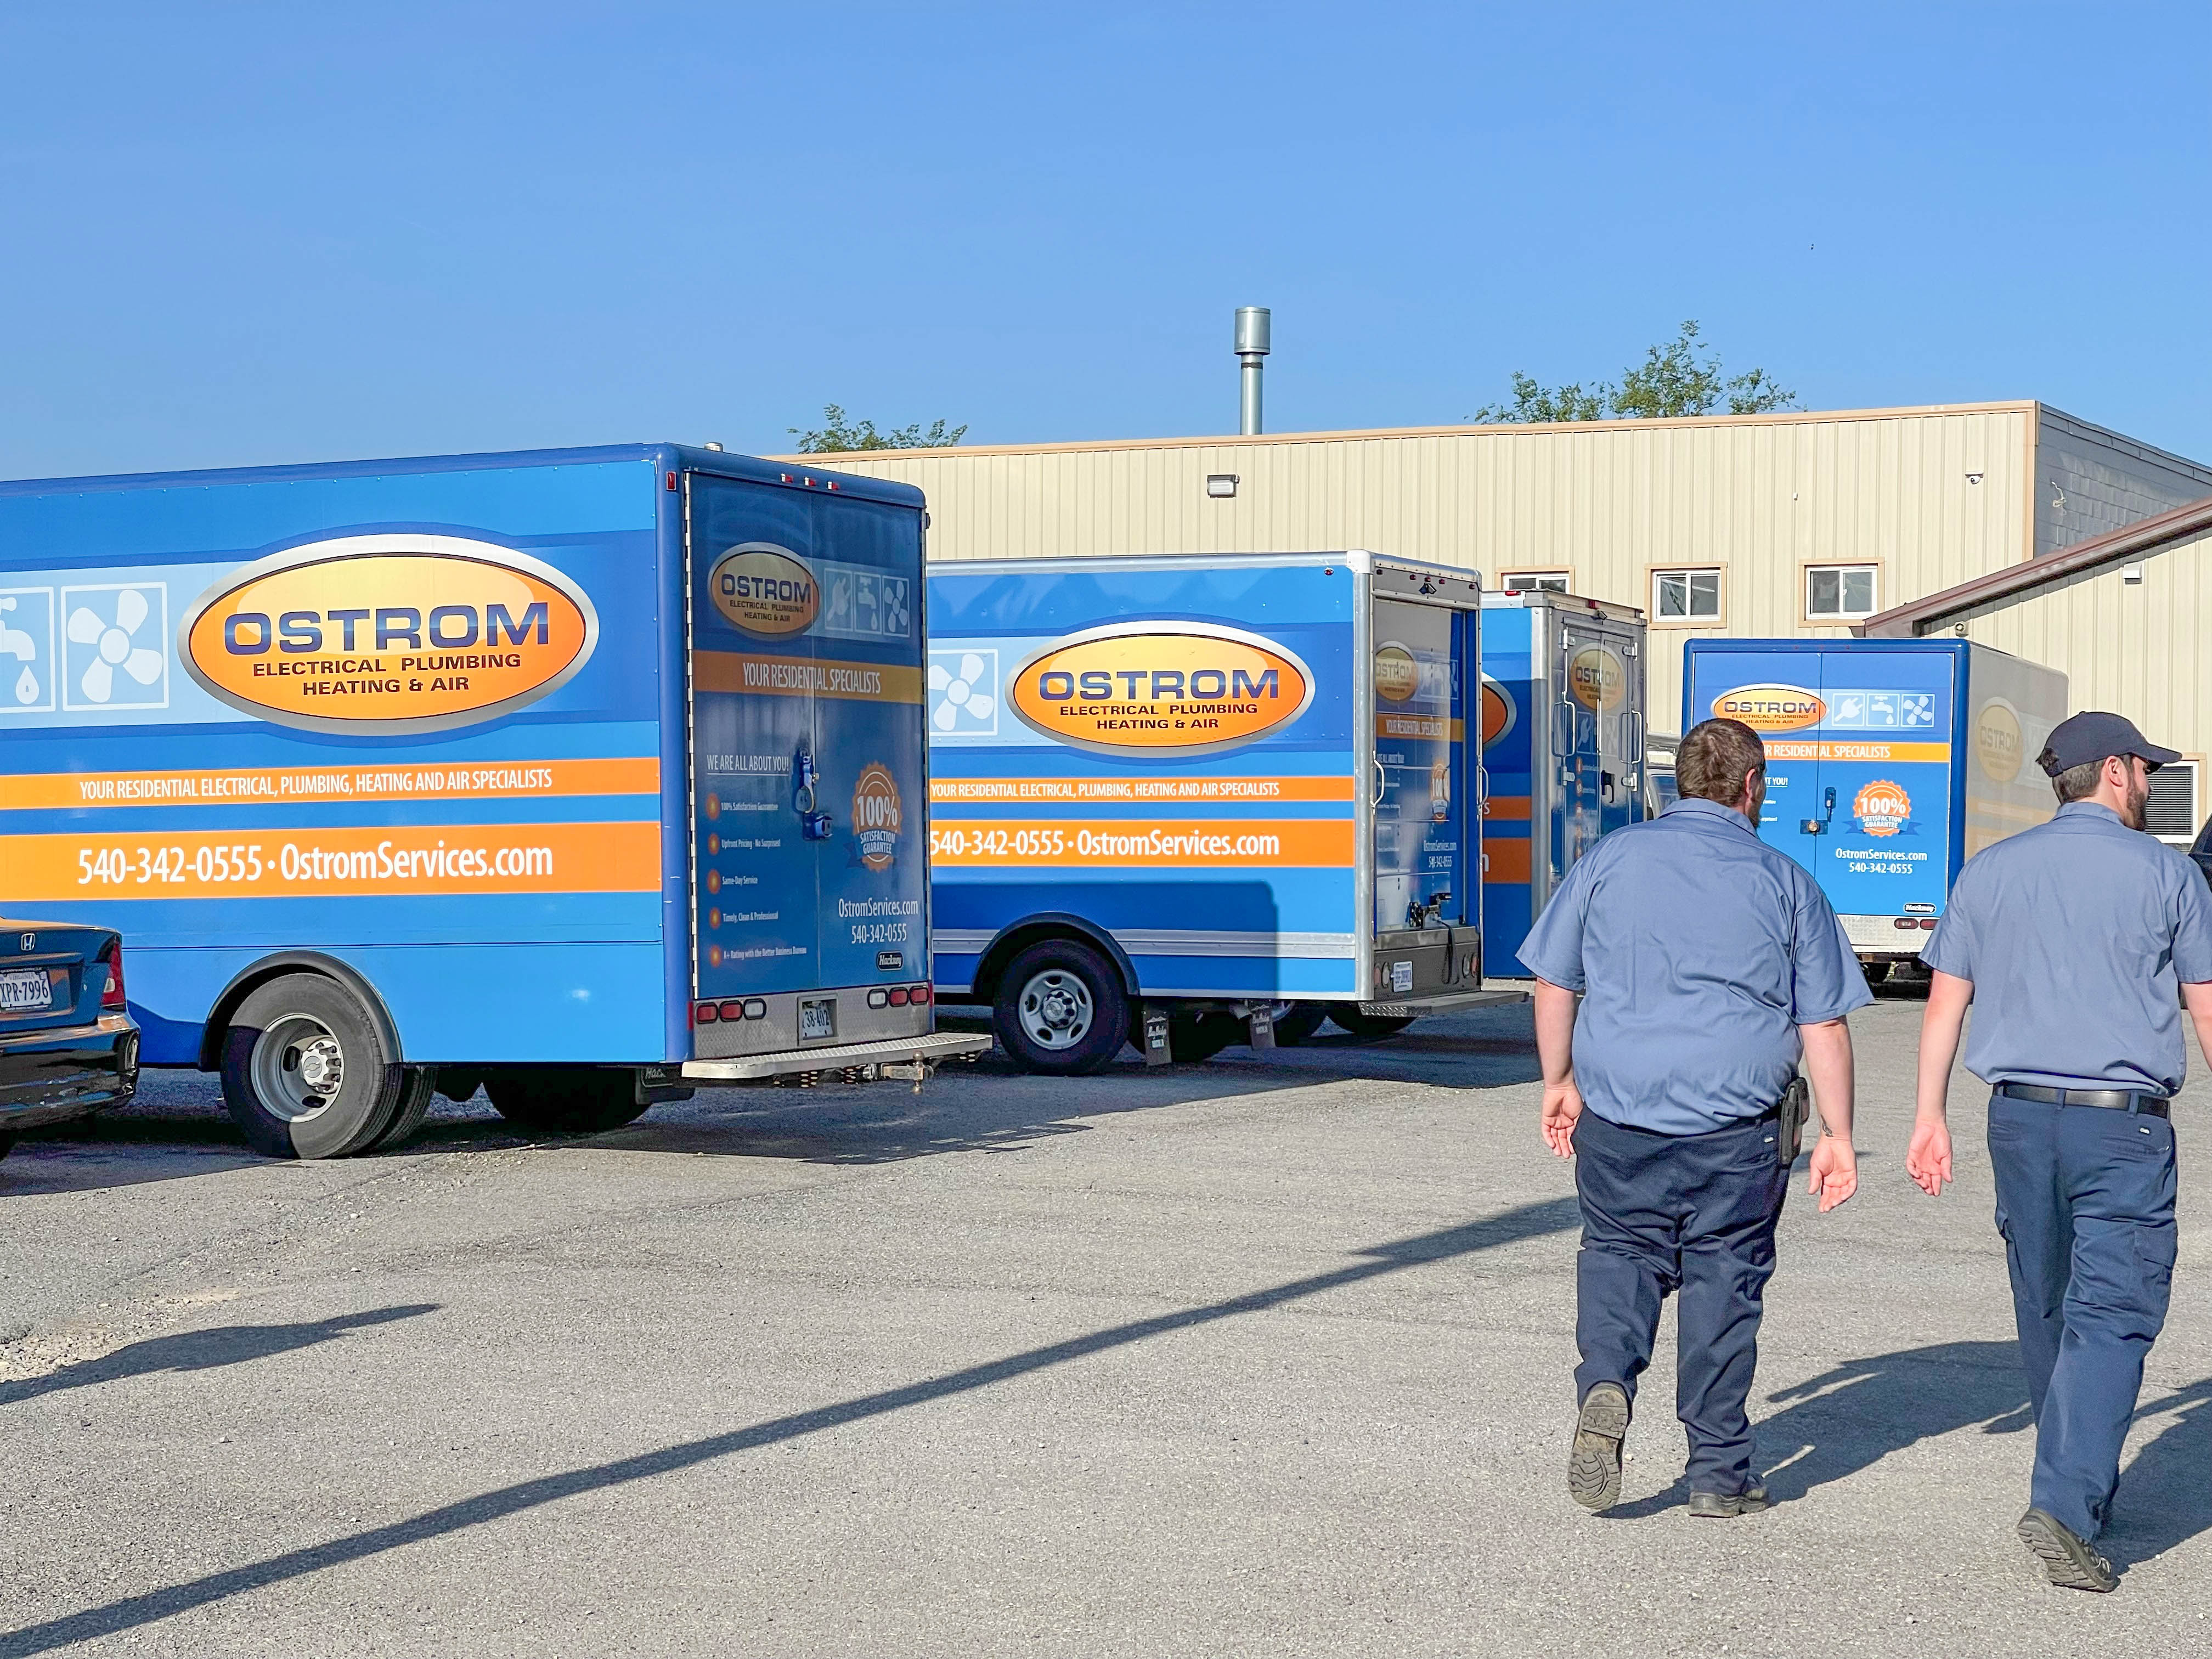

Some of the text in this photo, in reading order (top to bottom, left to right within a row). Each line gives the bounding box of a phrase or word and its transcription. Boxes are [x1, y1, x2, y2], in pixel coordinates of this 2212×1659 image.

[721, 574, 810, 603] OSTROM
[730, 600, 804, 613] ELECTRICAL PLUMBING
[744, 612, 772, 620] HEATING
[225, 602, 548, 654] OSTROM
[253, 654, 521, 676] ELECTRICAL PLUMBING
[303, 677, 469, 695] HEATING & AIR
[743, 663, 881, 694] YOUR RESIDENTIAL SPECIALISTS
[1040, 669, 1278, 700] OSTROM
[1060, 704, 1258, 716] ELECTRICAL PLUMBING
[1724, 702, 1816, 713] OSTROM
[1097, 718, 1219, 730] HEATING & AIR
[1774, 745, 1832, 757] RESIDENTIAL
[1834, 746, 1891, 758] SPECIALISTS
[707, 754, 789, 771] WE ARE ALL ABOUT YOU!
[80, 769, 552, 799] YOUR RESIDENTIAL ELECTRICAL, PLUMBING, HEATING AND AIR SPECIALISTS
[1773, 777, 1788, 786] YOU!
[931, 782, 1279, 799] YOUR RESIDENTIAL ELECTRICAL, PLUMBING, HEATING AND AIR SPECIALISTS
[857, 795, 898, 826] 100%
[1860, 797, 1906, 814] 100%
[738, 839, 752, 850] Pricing
[860, 831, 896, 844] SATISFACTION
[1077, 829, 1279, 855] OstromServices.com
[863, 842, 892, 854] GUARANTEE
[1836, 848, 1927, 861] OstromServices.com
[78, 840, 552, 884] 540-342-0555 OstromServices.com
[1849, 862, 1913, 874] 540-342-0555
[743, 876, 758, 884] Service
[838, 896, 918, 917] OstromServices.com
[851, 923, 907, 944] 540-342-0555
